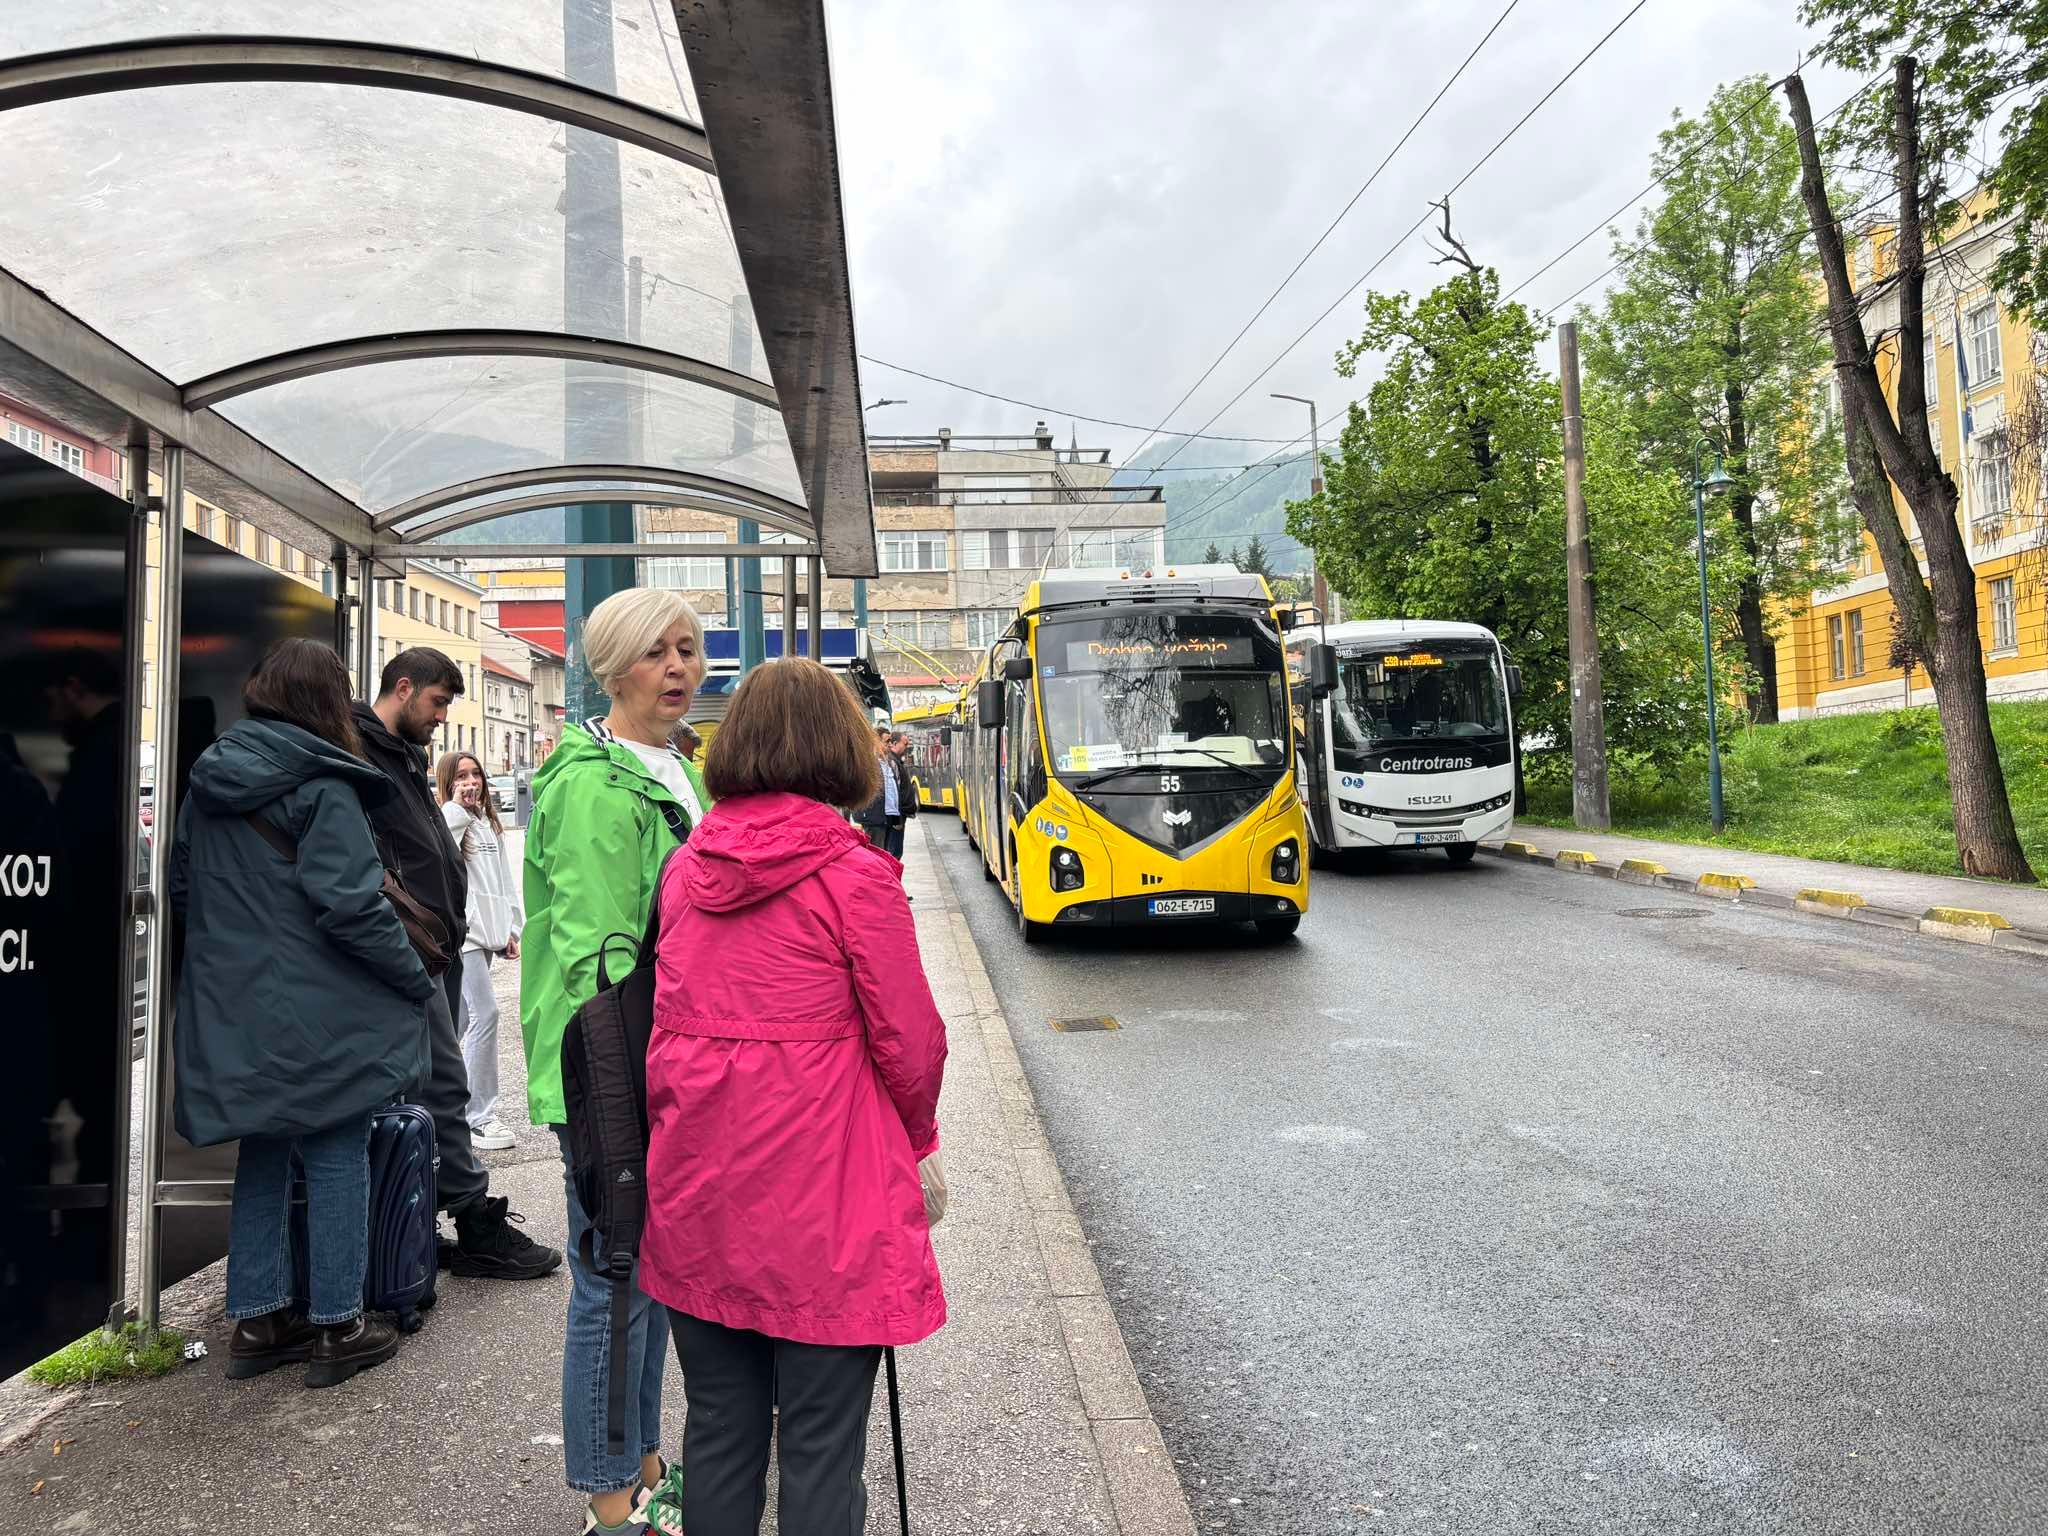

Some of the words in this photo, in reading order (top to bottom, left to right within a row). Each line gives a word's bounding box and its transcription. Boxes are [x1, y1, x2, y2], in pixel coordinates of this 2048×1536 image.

[1380, 756, 1473, 772] Centrotrans
[1160, 775, 1181, 793] 55
[1407, 794, 1452, 805] ISUZU
[0, 854, 51, 897] KOJ
[1156, 899, 1213, 913] 062-E-715
